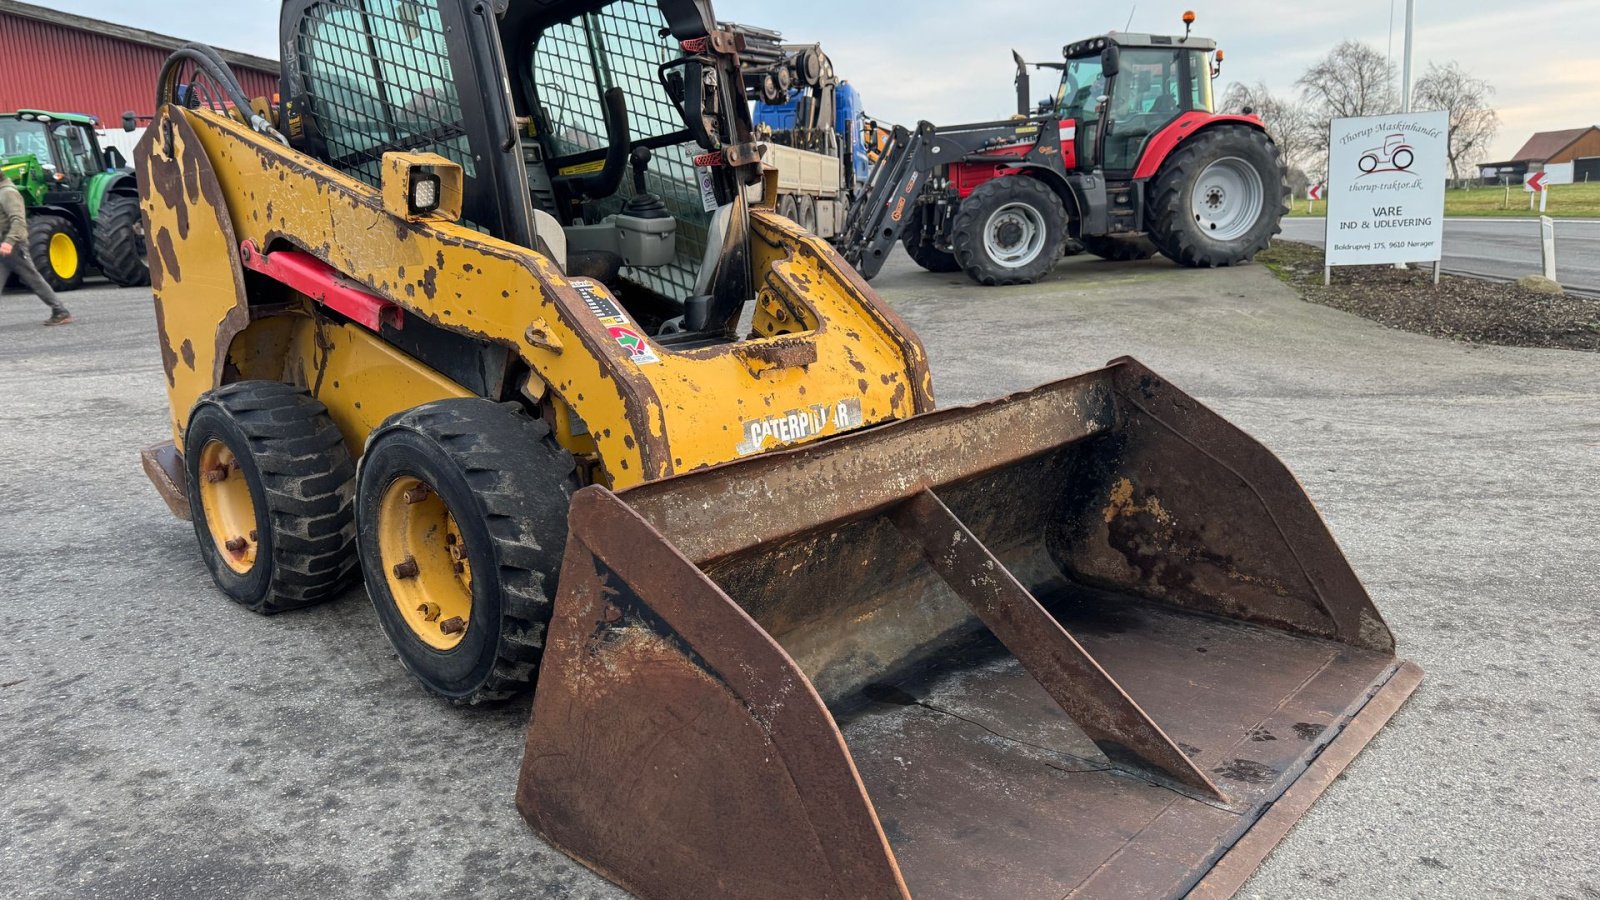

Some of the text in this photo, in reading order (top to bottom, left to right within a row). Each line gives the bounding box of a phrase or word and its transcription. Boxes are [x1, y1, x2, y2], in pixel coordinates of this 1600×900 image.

[1339, 120, 1442, 145] Thorup Maskinhandel
[1349, 179, 1423, 193] thorup-traktor.dk
[1372, 206, 1403, 217] VARE
[1340, 217, 1432, 230] IND & UDLEVERING
[1334, 242, 1371, 251] Boldrupvej
[1389, 240, 1405, 249] 9610
